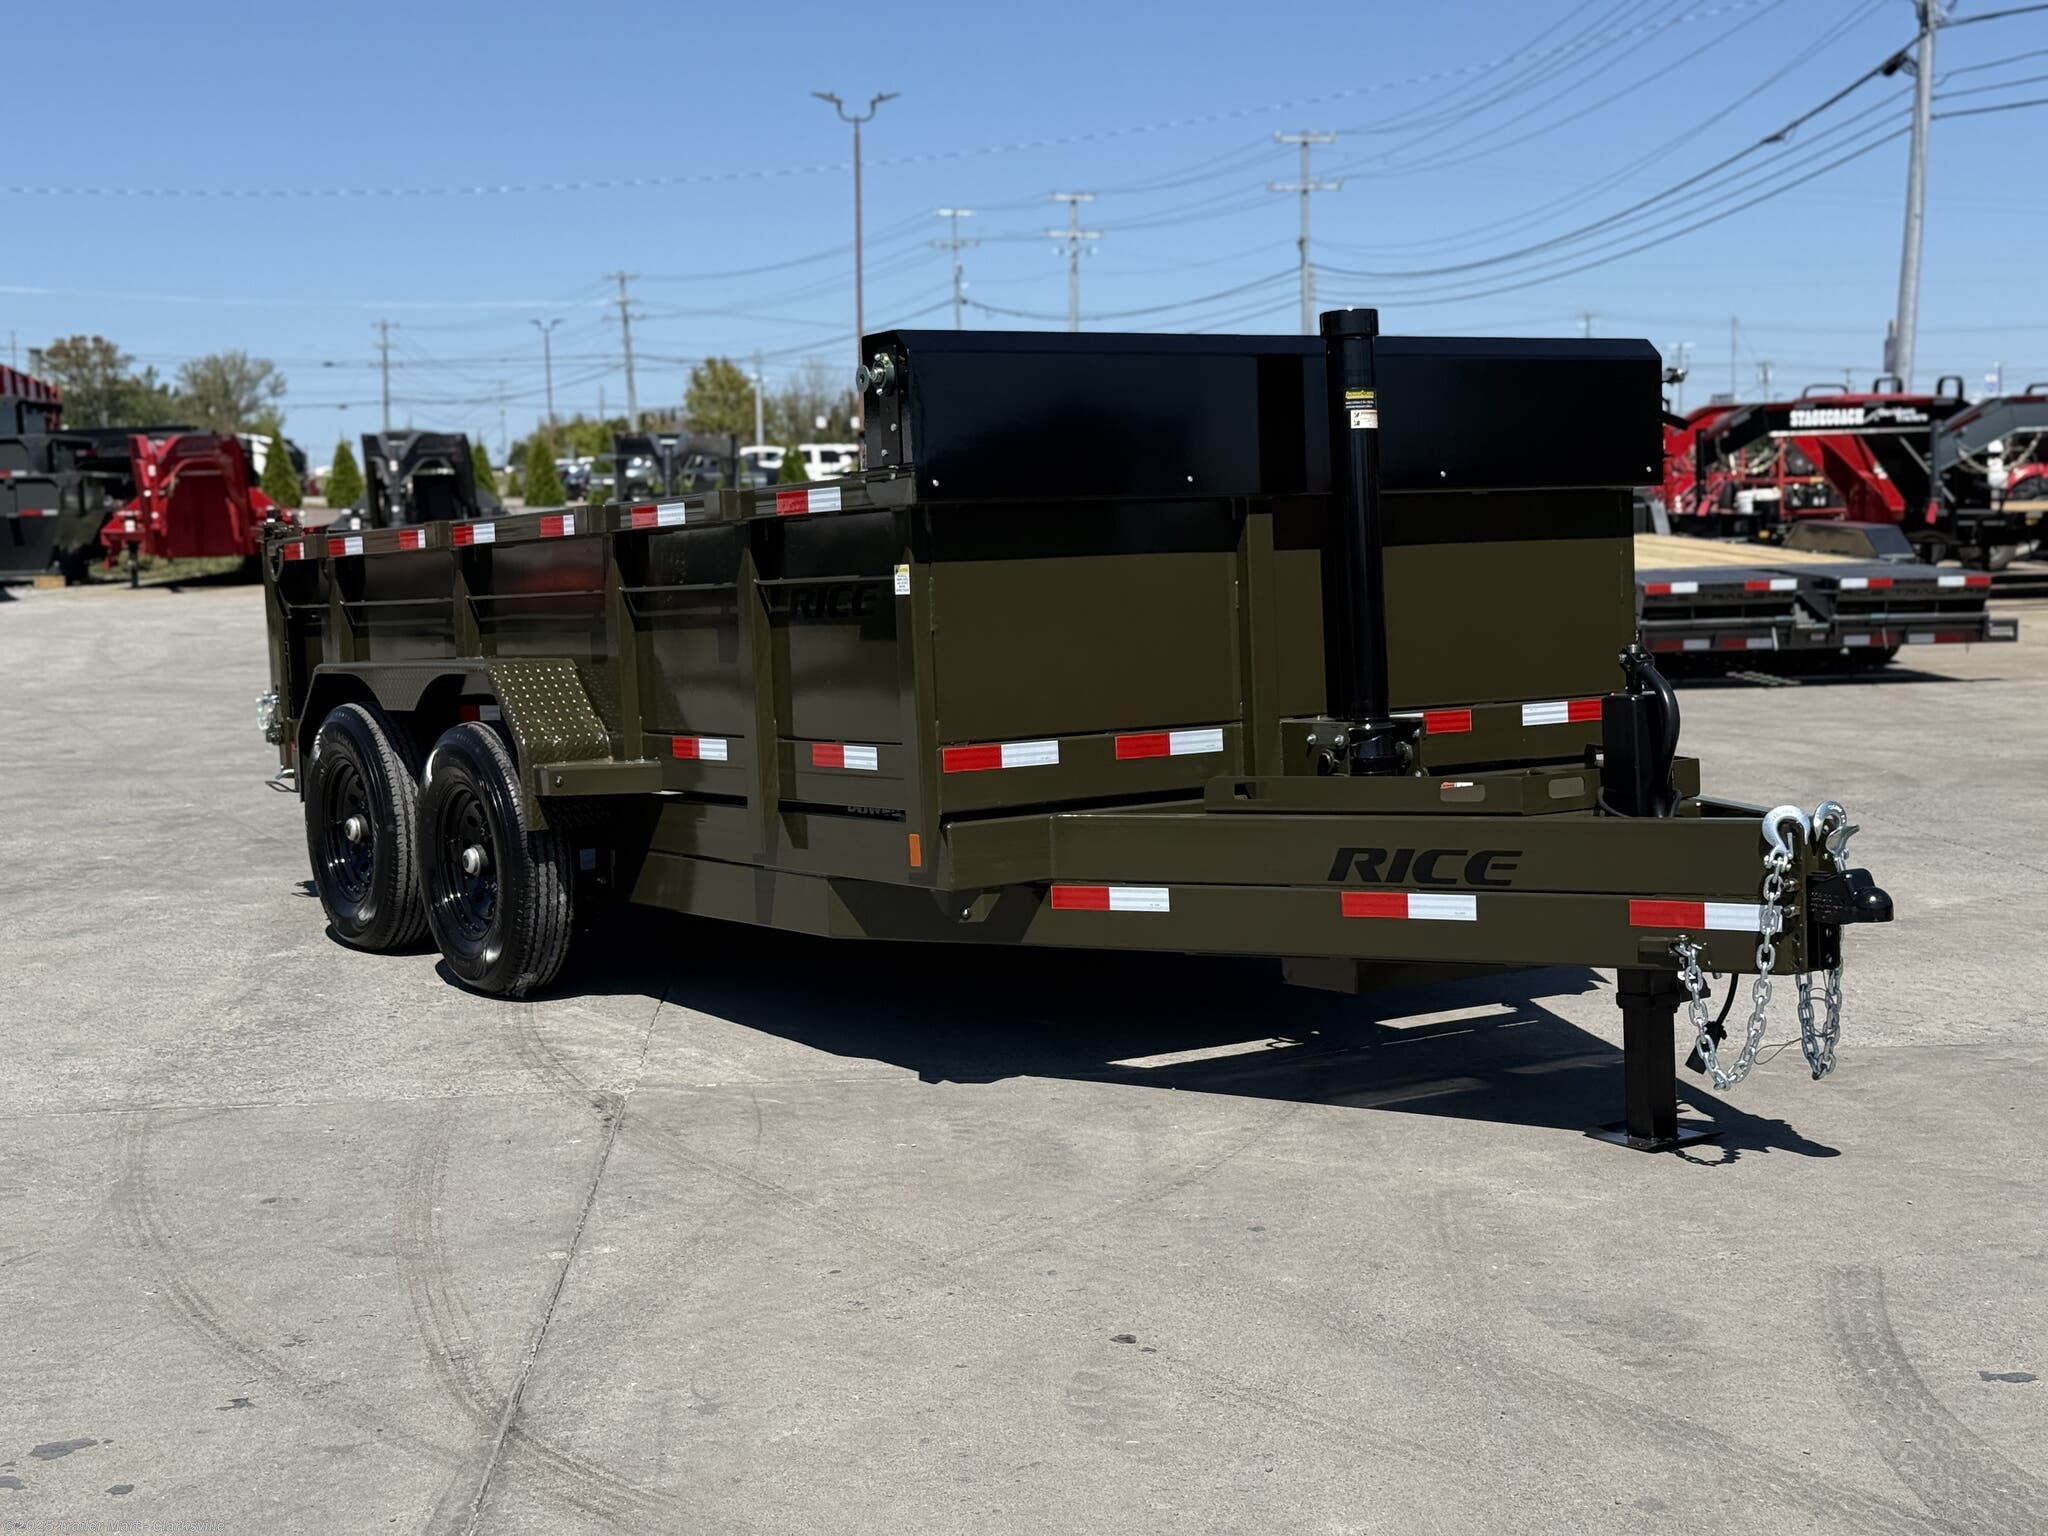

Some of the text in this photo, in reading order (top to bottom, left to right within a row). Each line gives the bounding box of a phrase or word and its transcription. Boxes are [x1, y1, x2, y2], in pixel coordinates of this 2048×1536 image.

[1790, 408, 1865, 427] STAGECOACH
[789, 584, 878, 617] RICE
[1328, 847, 1523, 886] RICE
